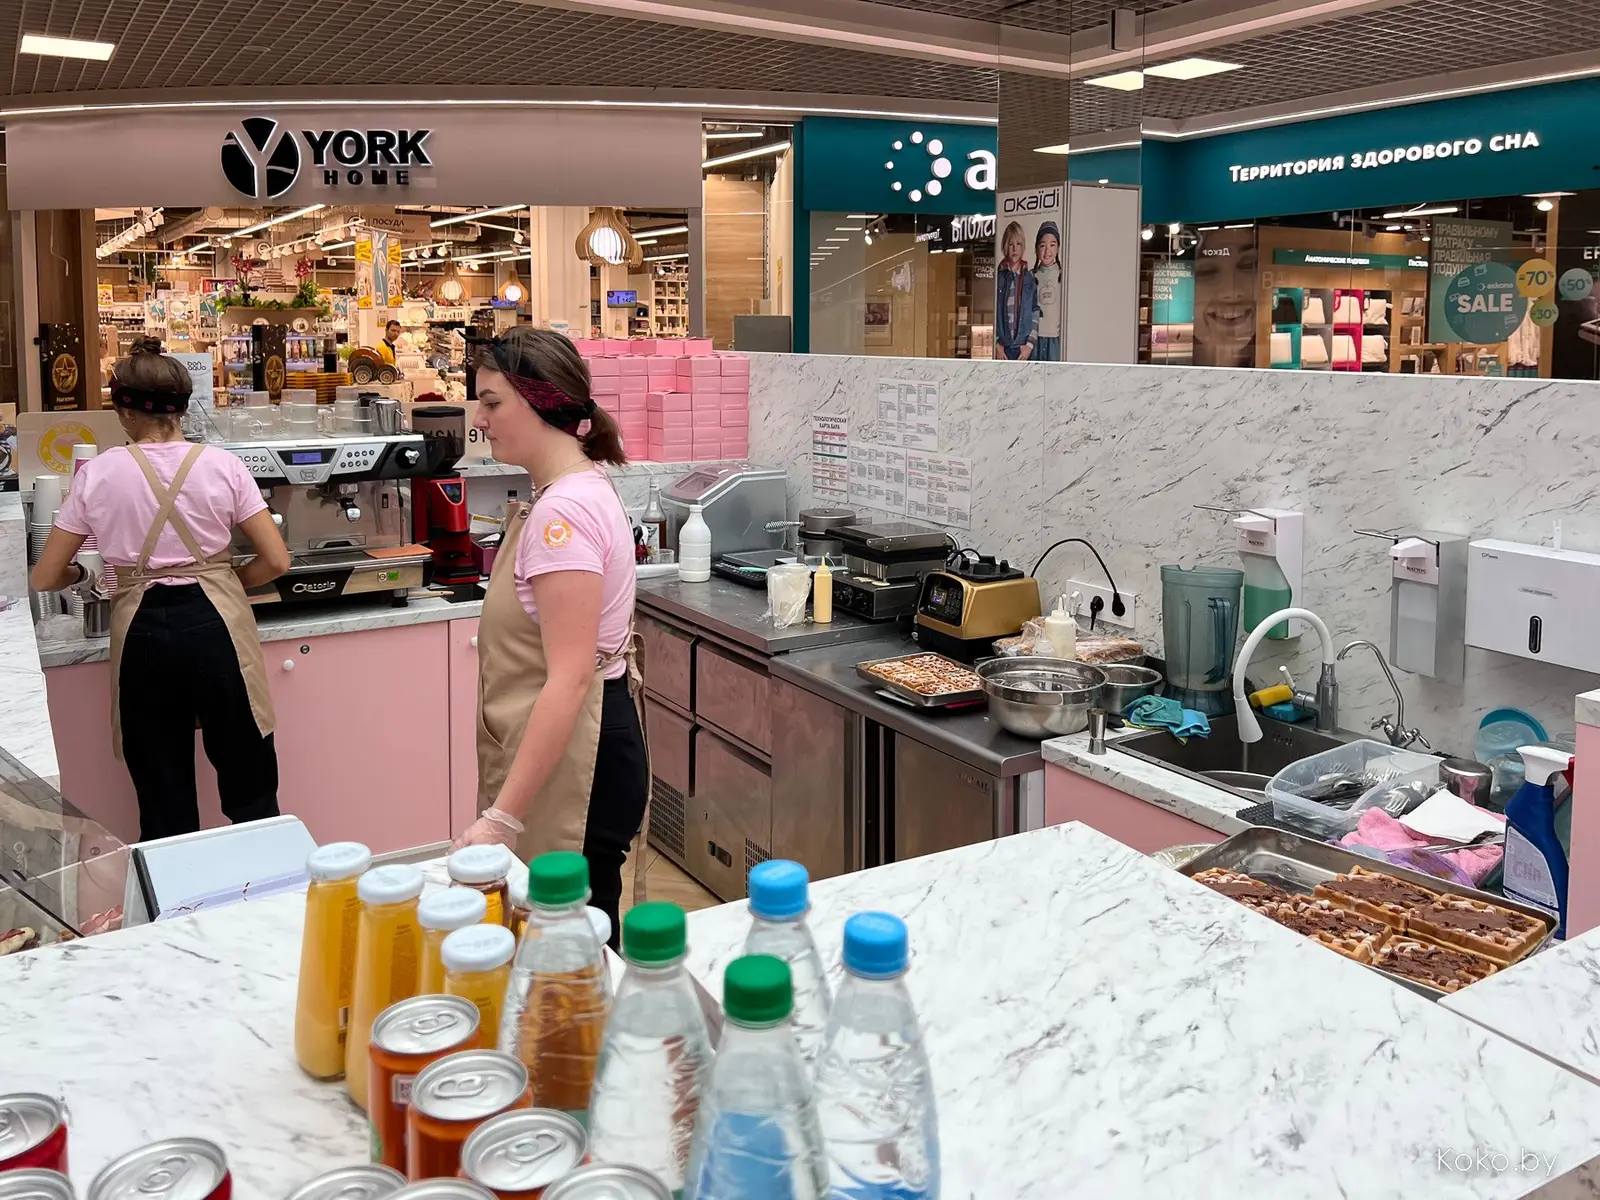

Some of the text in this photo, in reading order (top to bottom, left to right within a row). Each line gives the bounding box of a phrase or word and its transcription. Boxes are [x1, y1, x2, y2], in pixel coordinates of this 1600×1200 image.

[301, 129, 434, 167] YORK
[1350, 138, 1483, 169] ЗДОРОВОГО
[1489, 130, 1540, 152] СНА
[324, 169, 409, 186] HOME
[372, 217, 405, 227] ПОСУДА
[1434, 223, 1500, 238] ПРАВИЛЬНОМУ
[1433, 250, 1492, 263] ПРАВИЛЬНАЯ
[1457, 294, 1513, 313] SALE
